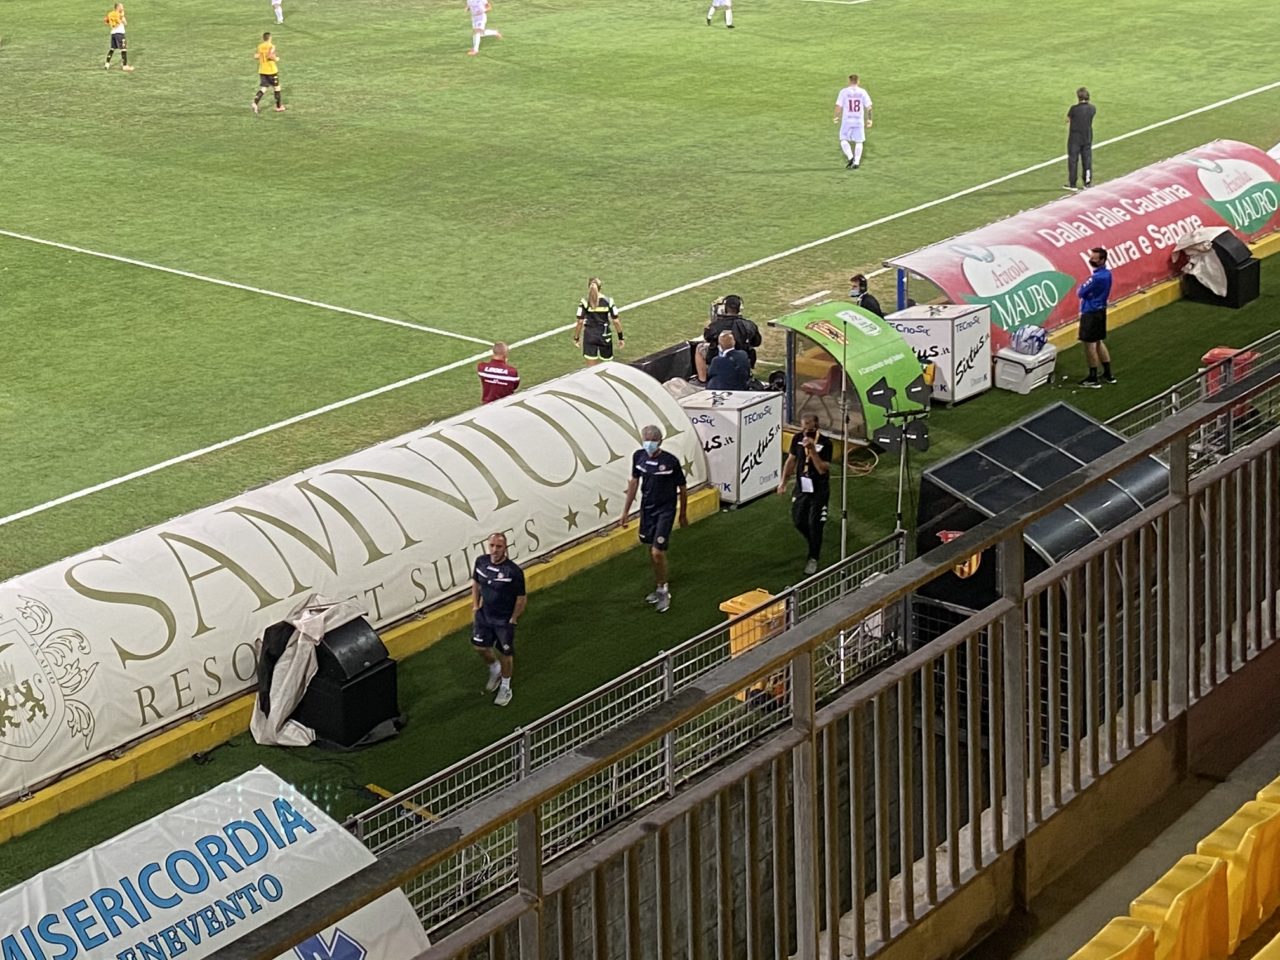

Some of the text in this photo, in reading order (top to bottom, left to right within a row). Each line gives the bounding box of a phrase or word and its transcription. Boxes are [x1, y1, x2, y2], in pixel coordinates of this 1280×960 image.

[848, 99, 861, 113] 18
[1037, 183, 1193, 248] Dalla Valle Caudina
[1225, 187, 1279, 231] MAURO
[1080, 213, 1204, 276] Ntura e Sapore
[991, 279, 1059, 332] MAURO
[64, 368, 685, 670] SAMNIUM
[410, 517, 540, 606] SUITES
